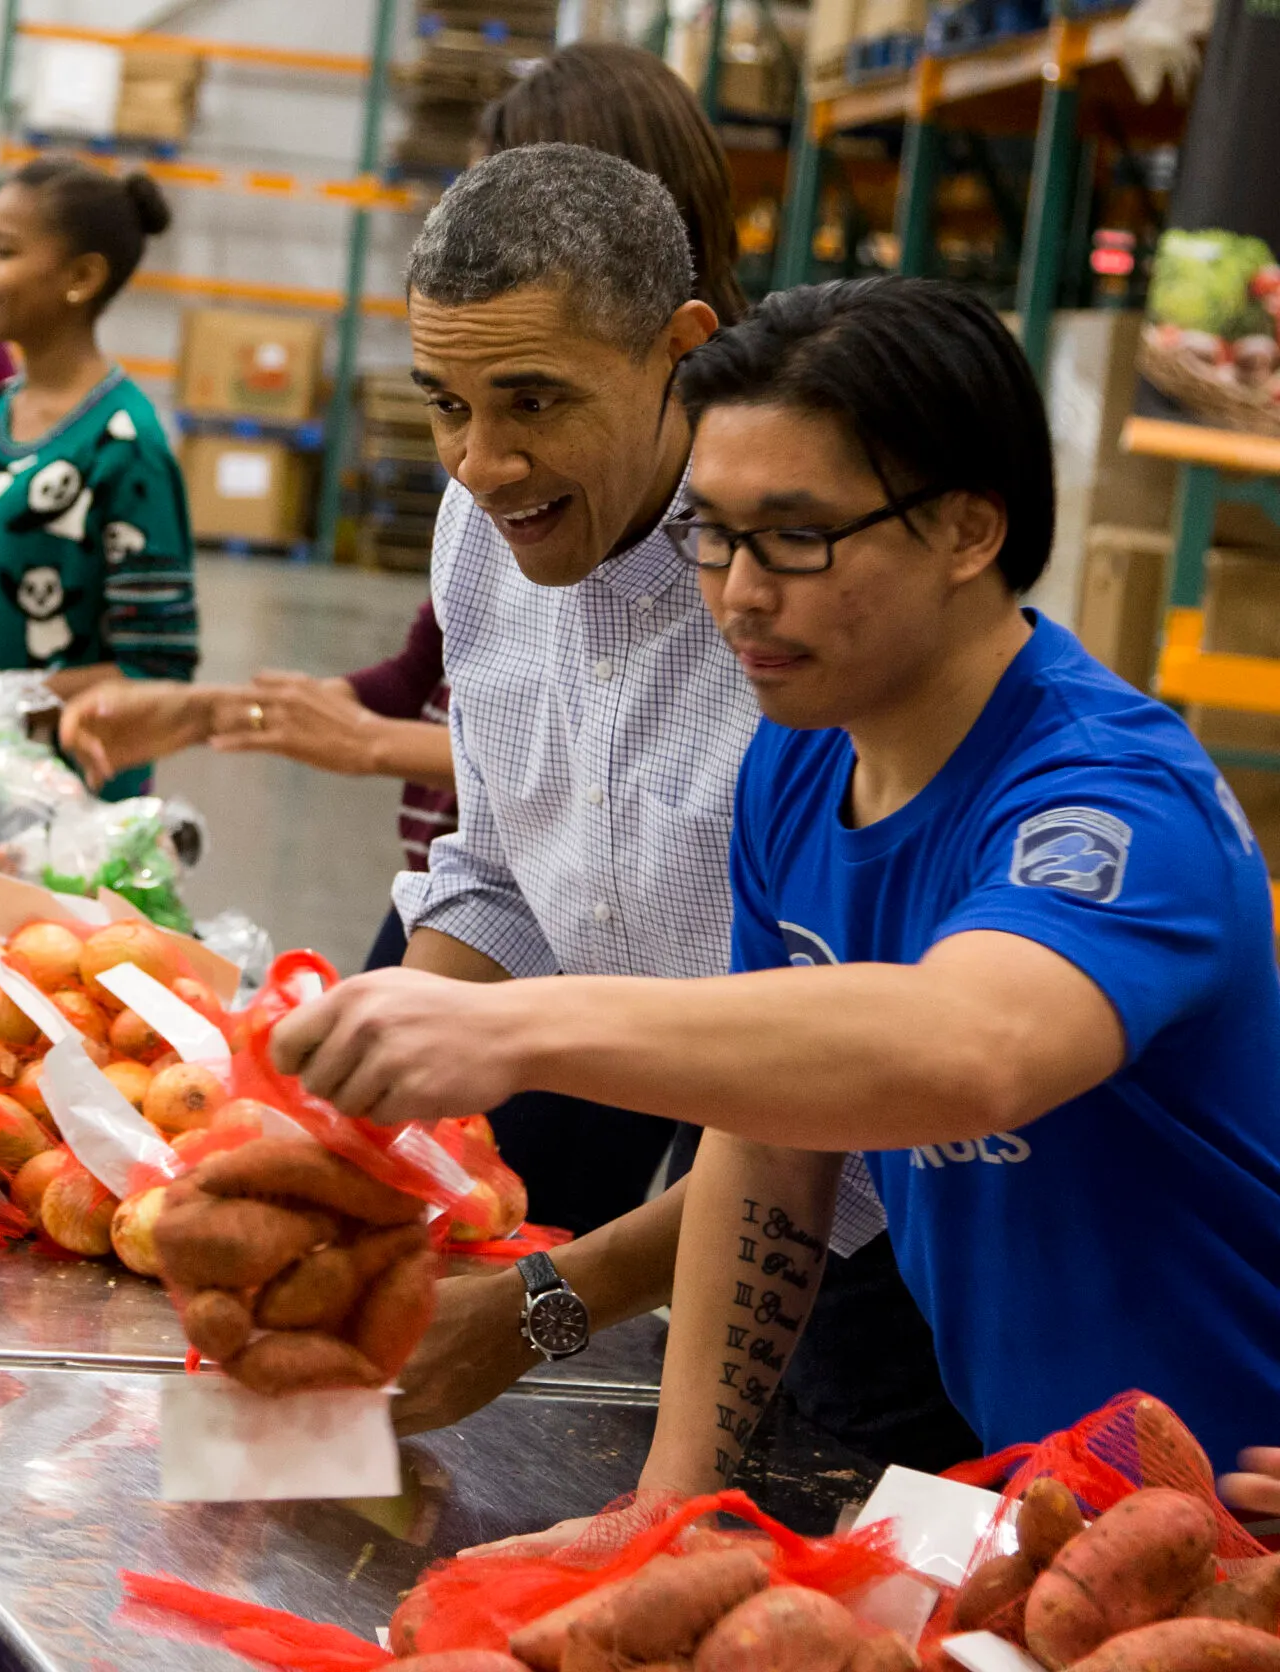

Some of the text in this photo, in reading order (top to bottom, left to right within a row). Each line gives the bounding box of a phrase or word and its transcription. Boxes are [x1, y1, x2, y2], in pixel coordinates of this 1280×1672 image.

[738, 1236, 757, 1262] II
[734, 1281, 754, 1307] III
[727, 1324, 750, 1350] IV
[719, 1362, 741, 1387] V
